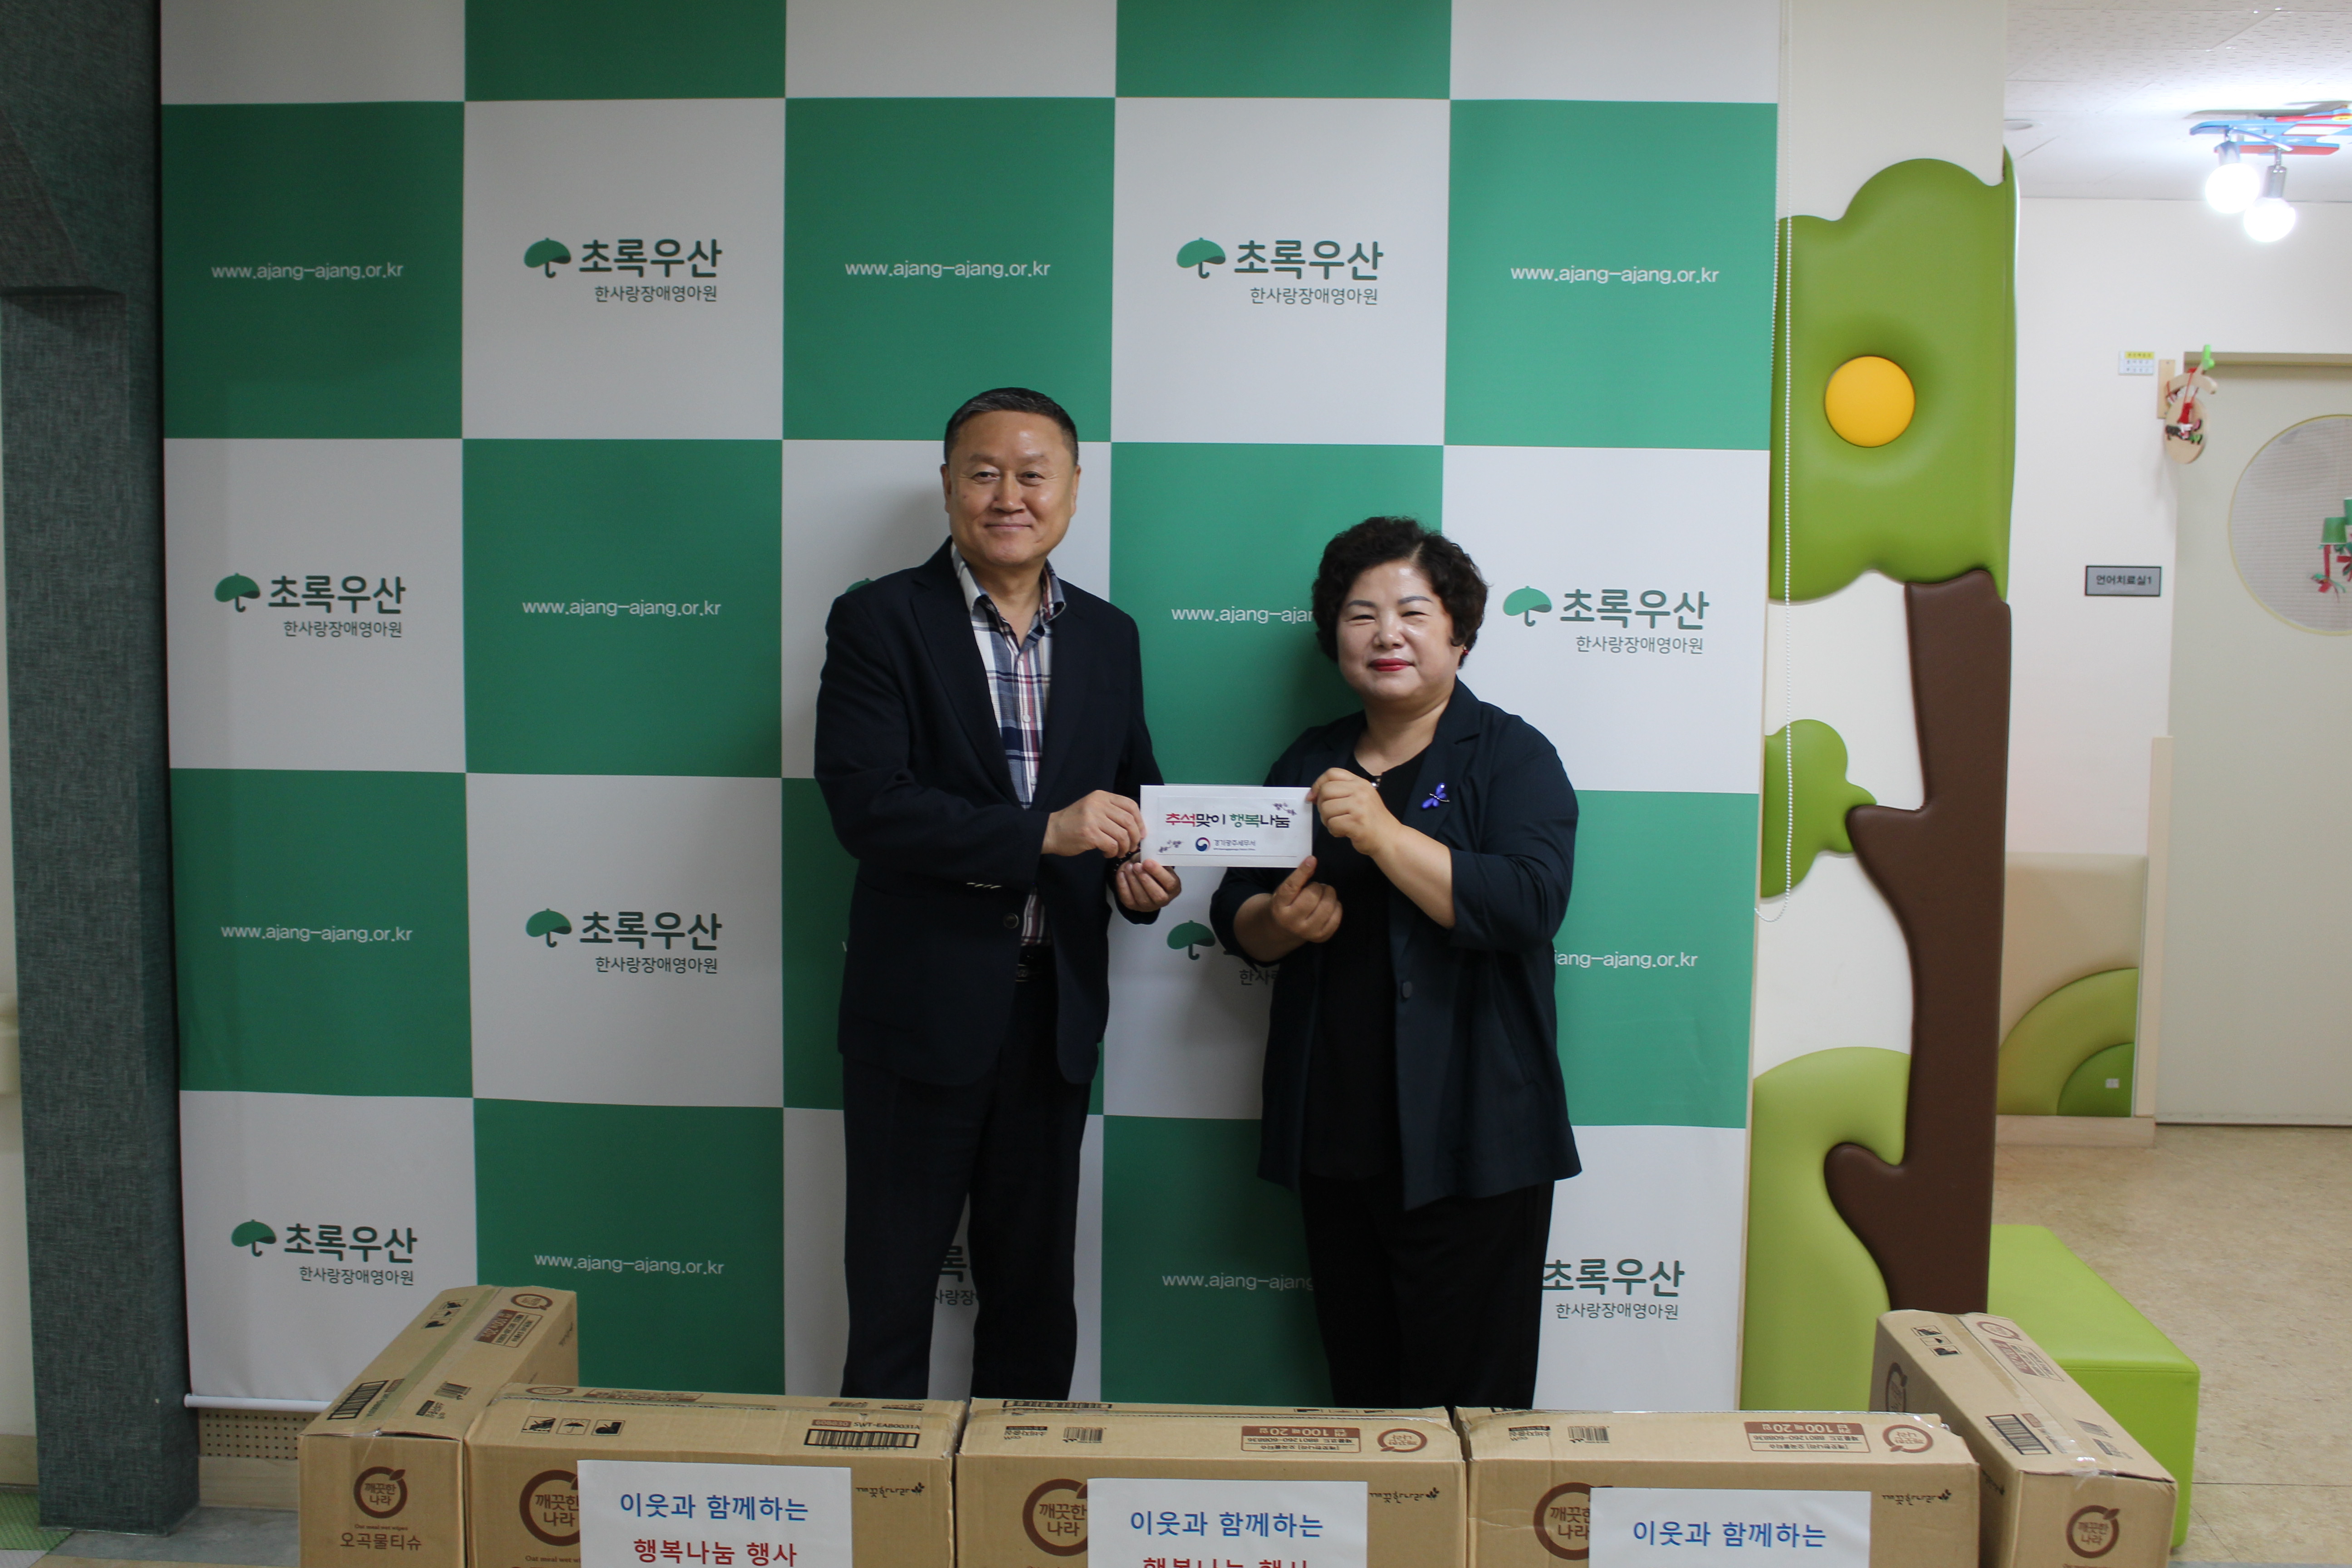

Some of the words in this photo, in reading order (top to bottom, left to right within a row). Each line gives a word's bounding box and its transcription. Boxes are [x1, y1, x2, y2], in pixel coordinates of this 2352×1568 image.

[579, 239, 722, 278] 초록우산
[1235, 240, 1383, 280] 초록우산
[211, 262, 404, 281] www.ajang-ajang.or.kr
[846, 260, 1051, 279] www.ajang-ajang.or.kr
[1510, 265, 1720, 284] www.ajang-ajang.or.kr
[595, 286, 716, 303] 한사랑장애영아원
[1251, 287, 1377, 305] 한사랑장애영아원
[2096, 575, 2151, 586] 언어치료실1
[268, 575, 406, 614] 초록우산
[522, 599, 721, 617] www.ajang-ajang.or.kr
[1171, 605, 1313, 624] www.ajang-aja
[1560, 588, 1710, 630] 초록우산
[284, 621, 402, 638] 한사랑장애영아원
[1576, 636, 1702, 654] 한사랑장애영아원
[1166, 813, 1225, 828] 추석맞이
[1230, 813, 1290, 828] 행복나눔
[221, 924, 413, 943] www.ajang-ajang.or.kr
[580, 911, 722, 951] 초록우산
[596, 957, 717, 974] 한사랑장애영아원
[1554, 950, 1698, 969] jang-ajang.or.kr
[284, 1223, 417, 1263] 초록우산
[534, 1254, 724, 1274] www.ajang-ajang.or.kr
[300, 1268, 413, 1286] 한사랑장애영아원
[1162, 1273, 1313, 1291] www.ajang-ajang
[1543, 1259, 1685, 1297] 초록우산
[1556, 1303, 1679, 1320] 한사랑장애영아원
[365, 1483, 397, 1496] 깨끗한
[369, 1495, 392, 1506] 나라
[620, 1493, 696, 1519] 이웃과
[706, 1494, 808, 1521] 함께하는
[544, 1512, 576, 1527] 나라
[1039, 1503, 1087, 1521] 깨끗한
[1047, 1521, 1080, 1536] 나라
[1131, 1511, 1208, 1536] 이웃과
[1219, 1511, 1323, 1538] 함께하는
[1558, 1524, 1589, 1539] 나라
[340, 1532, 422, 1551] 오곡물티슈
[1634, 1521, 1711, 1547] 이웃과
[1722, 1522, 1826, 1548] 함께하는
[2081, 1534, 2102, 1545] 나라
[633, 1539, 735, 1565] 행복나눔
[746, 1542, 797, 1567] 행사
